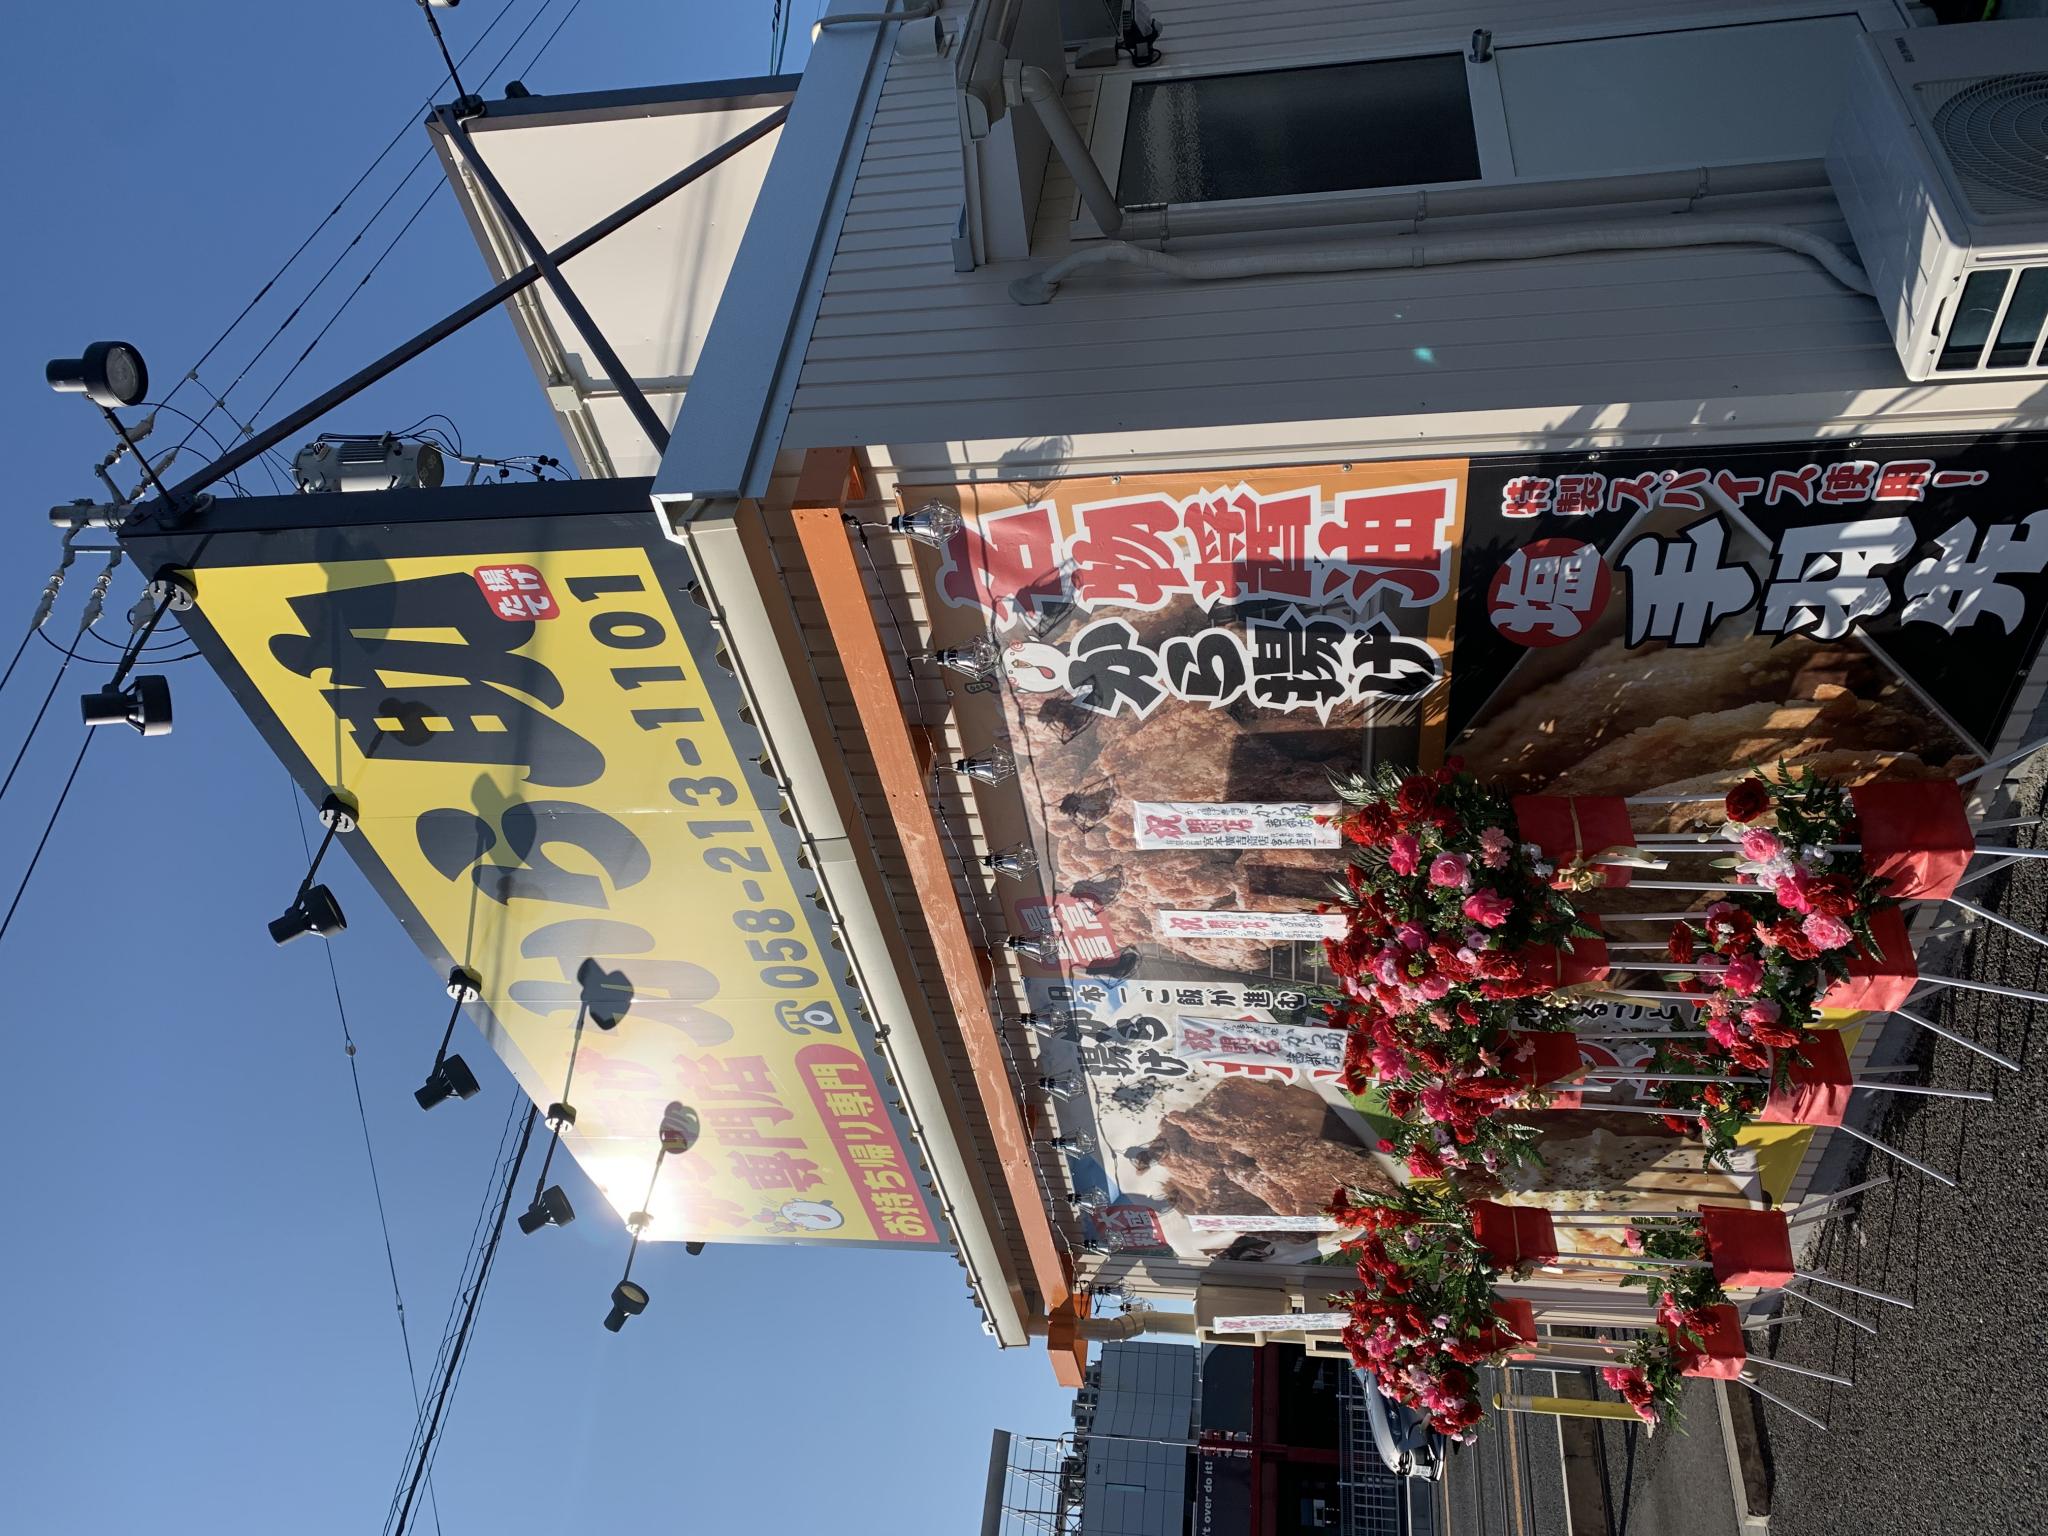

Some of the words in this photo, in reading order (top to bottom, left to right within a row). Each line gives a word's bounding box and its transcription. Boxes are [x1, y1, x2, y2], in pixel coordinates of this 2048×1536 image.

[1502, 458, 1990, 518] 特製スパイス使用！
[478, 567, 541, 592] 揚げ
[938, 480, 1454, 629] 名物醤油
[1490, 541, 1601, 637] 塩
[1615, 512, 2048, 646] 手羽先
[497, 594, 549, 617] たて
[1068, 612, 1444, 716] から揚げ
[268, 572, 735, 1047] から助
[565, 574, 819, 989] 058-213-1101
[1281, 1028, 1345, 1051] から助
[672, 1054, 823, 1192] 専門店
[815, 1062, 928, 1237] お持ち帰り専門
[1203, 1461, 1213, 1474] it!
[1203, 1478, 1212, 1493] do
[1203, 1496, 1212, 1524] over
